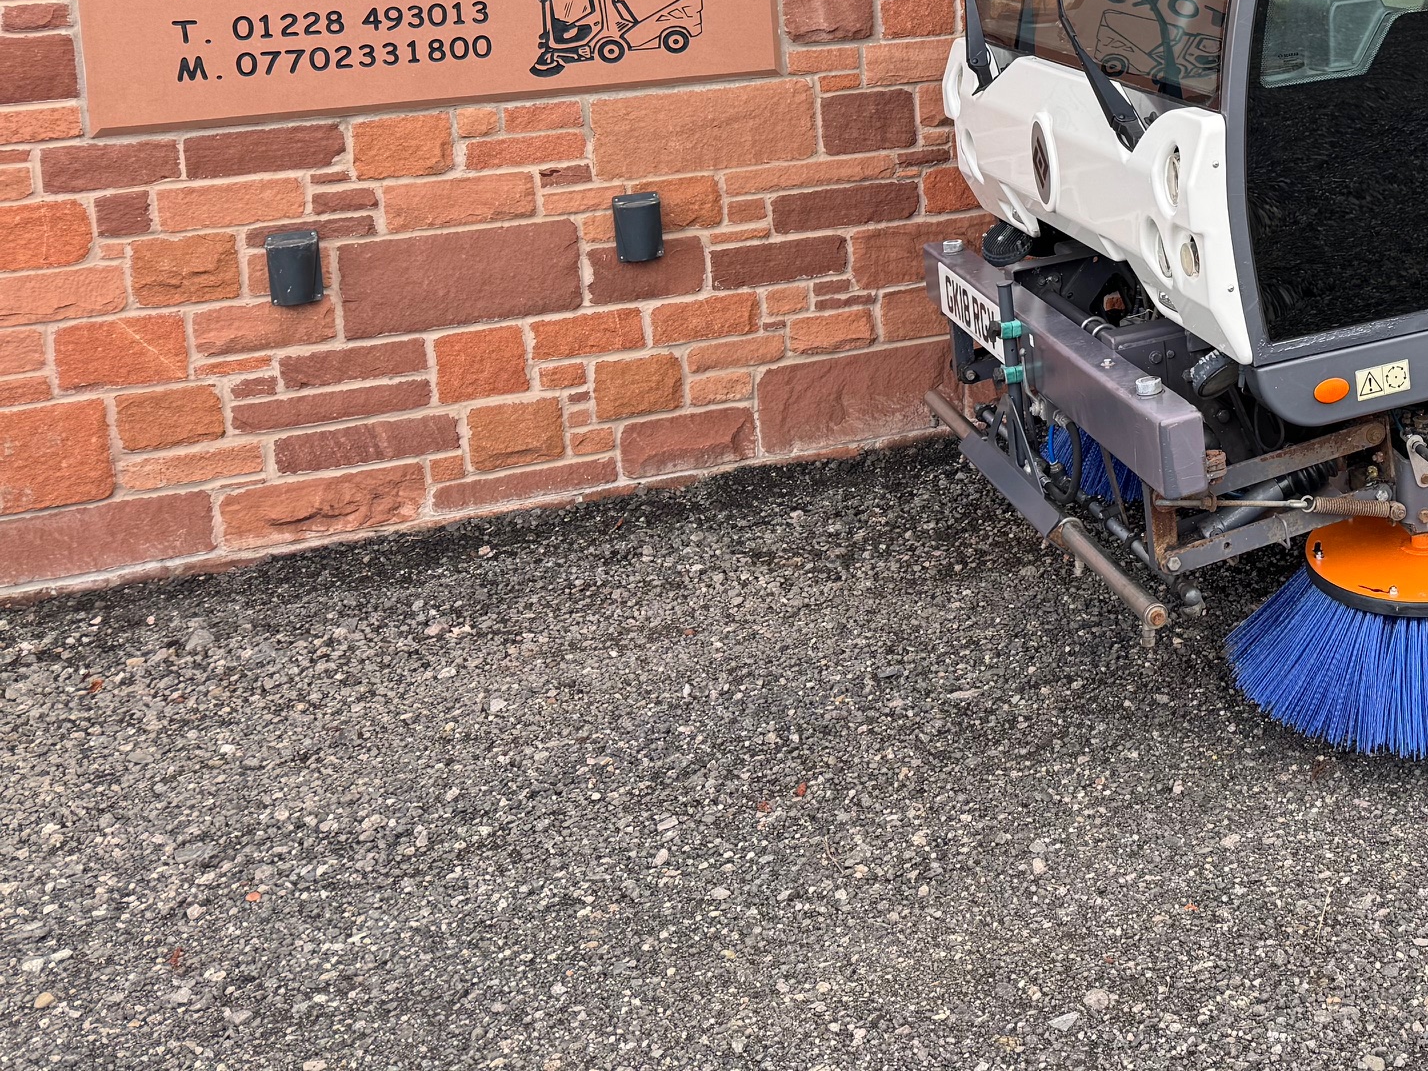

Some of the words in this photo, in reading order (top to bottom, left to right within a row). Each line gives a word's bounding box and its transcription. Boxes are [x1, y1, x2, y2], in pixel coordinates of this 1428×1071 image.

[171, 19, 212, 44] T.
[232, 10, 345, 41] 01228
[361, 0, 489, 32] 493013
[177, 55, 222, 83] M.
[235, 34, 492, 77] 07702331800
[945, 274, 972, 329] GK18
